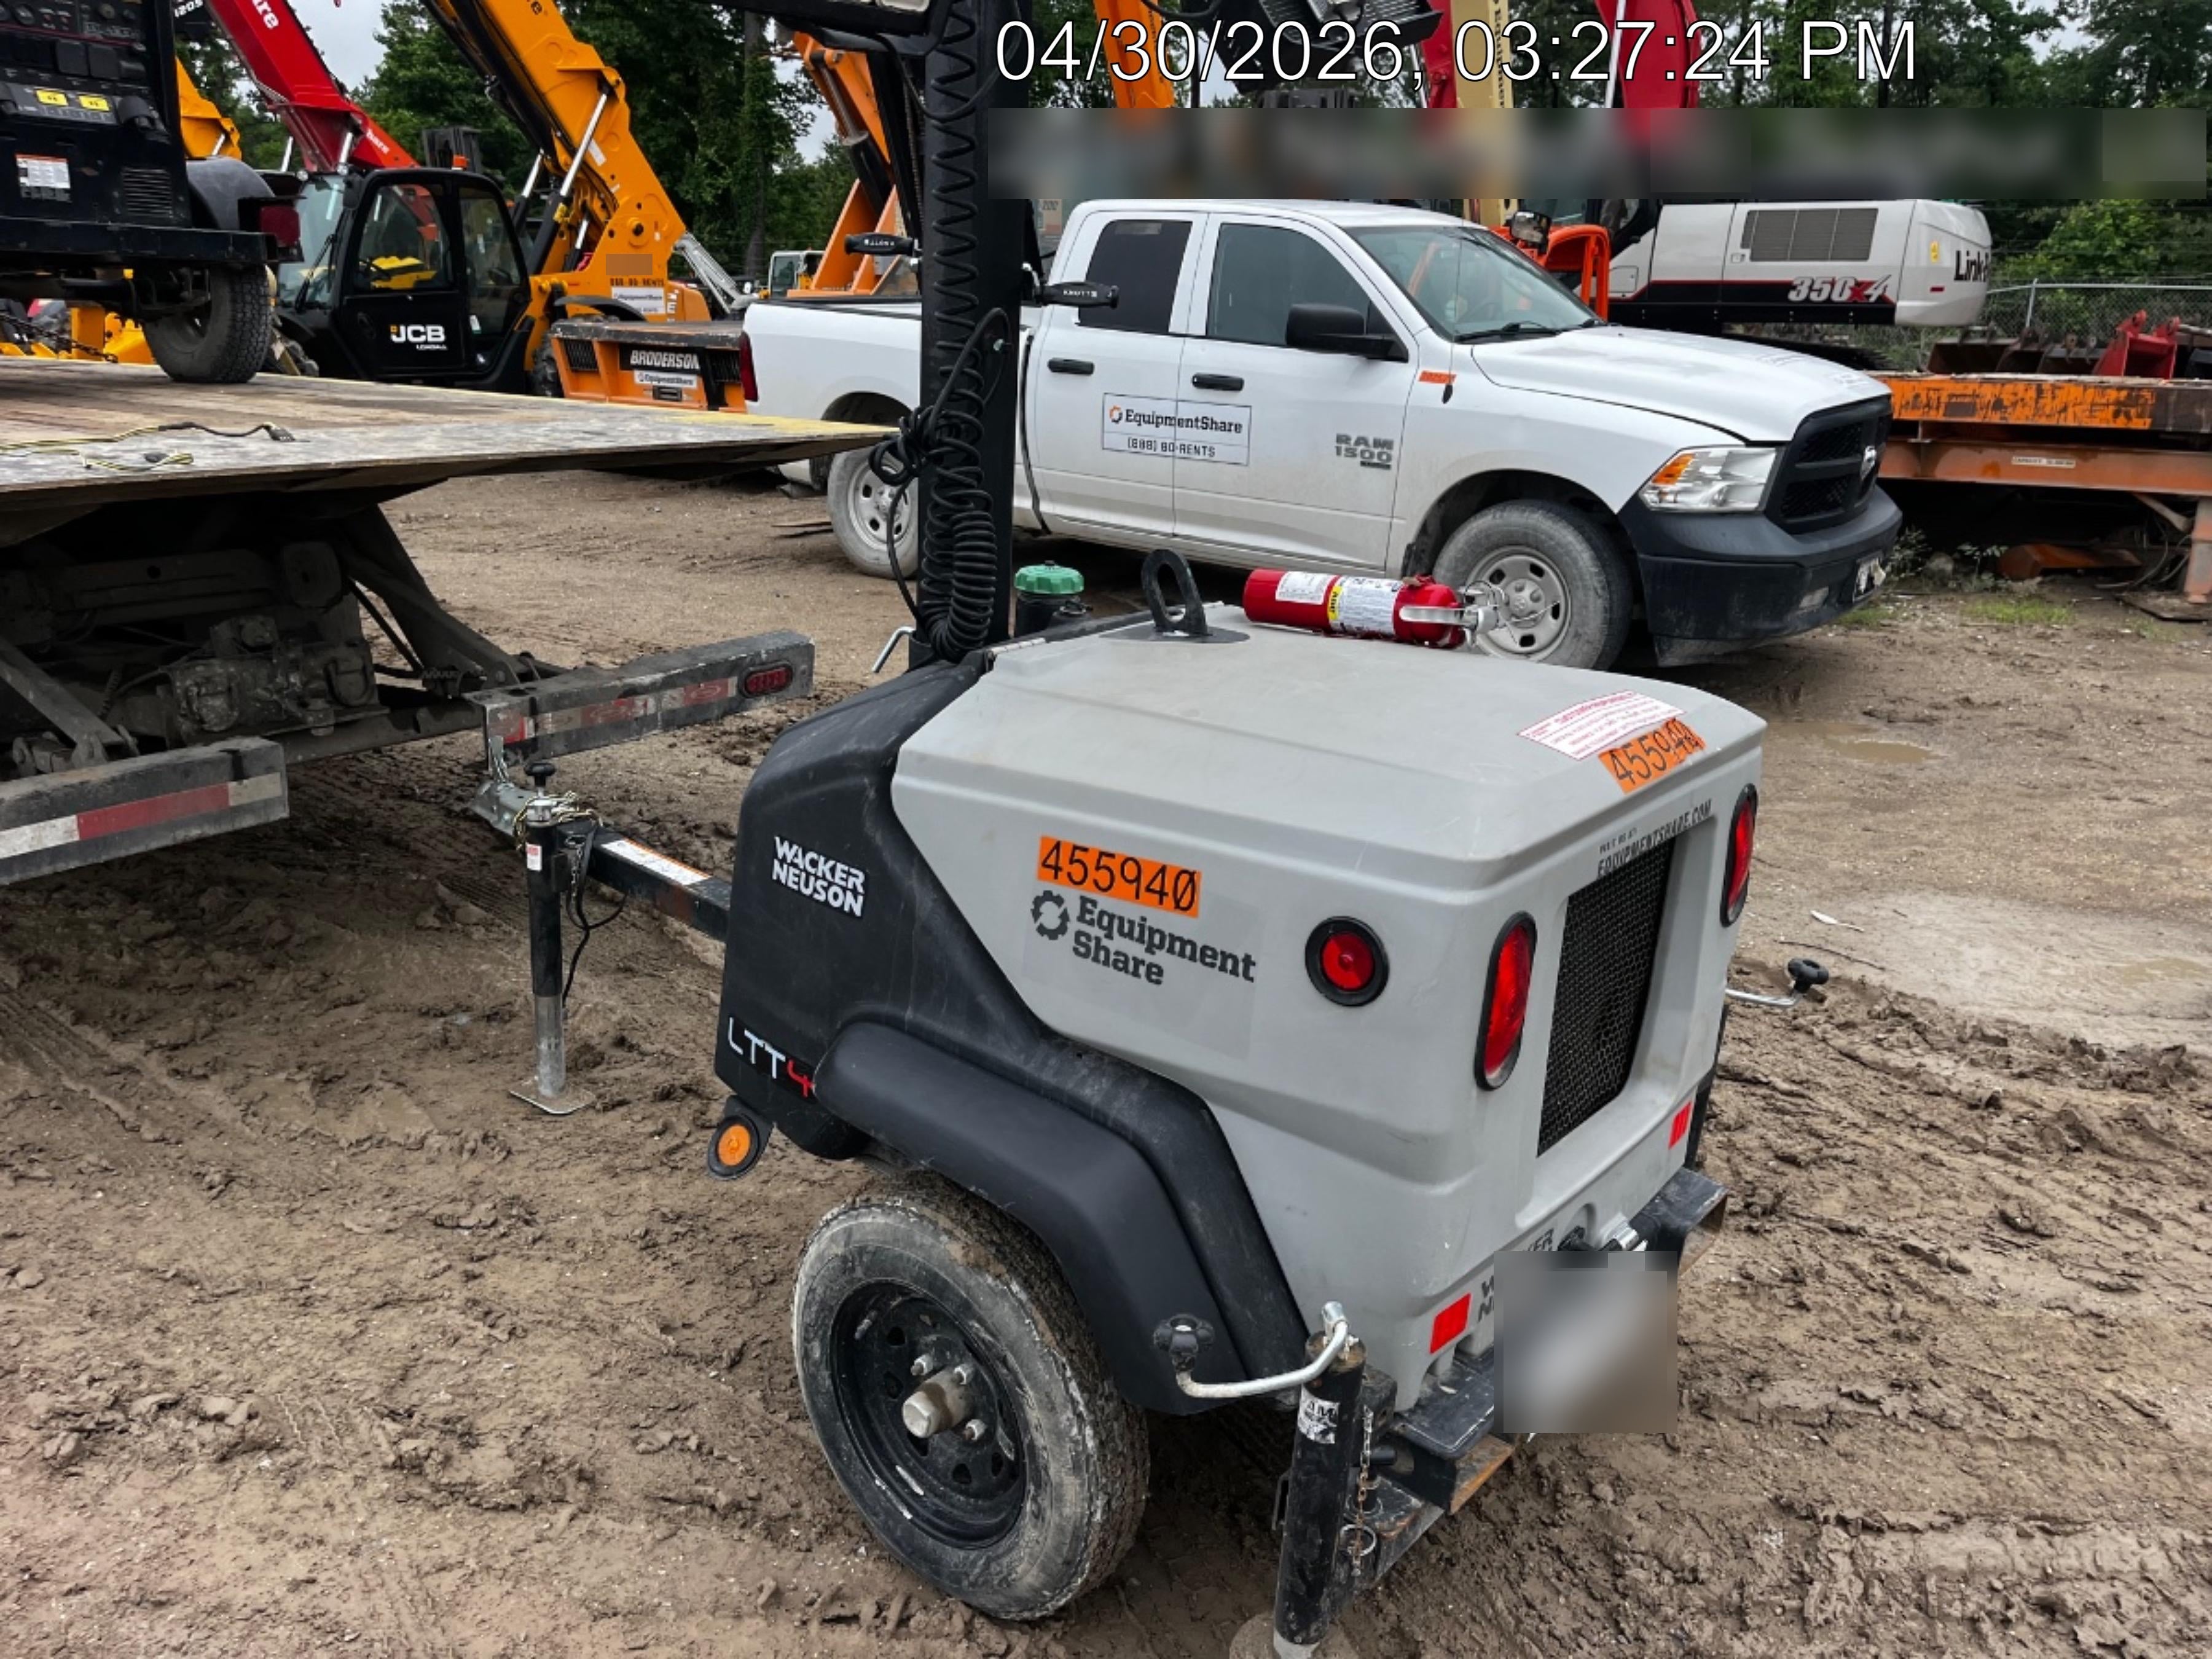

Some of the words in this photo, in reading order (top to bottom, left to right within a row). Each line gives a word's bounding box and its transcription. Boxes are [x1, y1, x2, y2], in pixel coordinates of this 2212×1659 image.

[390, 324, 445, 343] JCB
[630, 350, 700, 369] BRODERSON
[1124, 409, 1243, 434] EquipmentShare
[1335, 445, 1392, 463] 1500
[1336, 433, 1394, 451] RAM
[774, 836, 865, 894] WACKER
[1041, 841, 1198, 912] 455940
[772, 859, 864, 917] NEUSON
[1072, 930, 1164, 986] Share
[1076, 895, 1257, 983] Equipment
